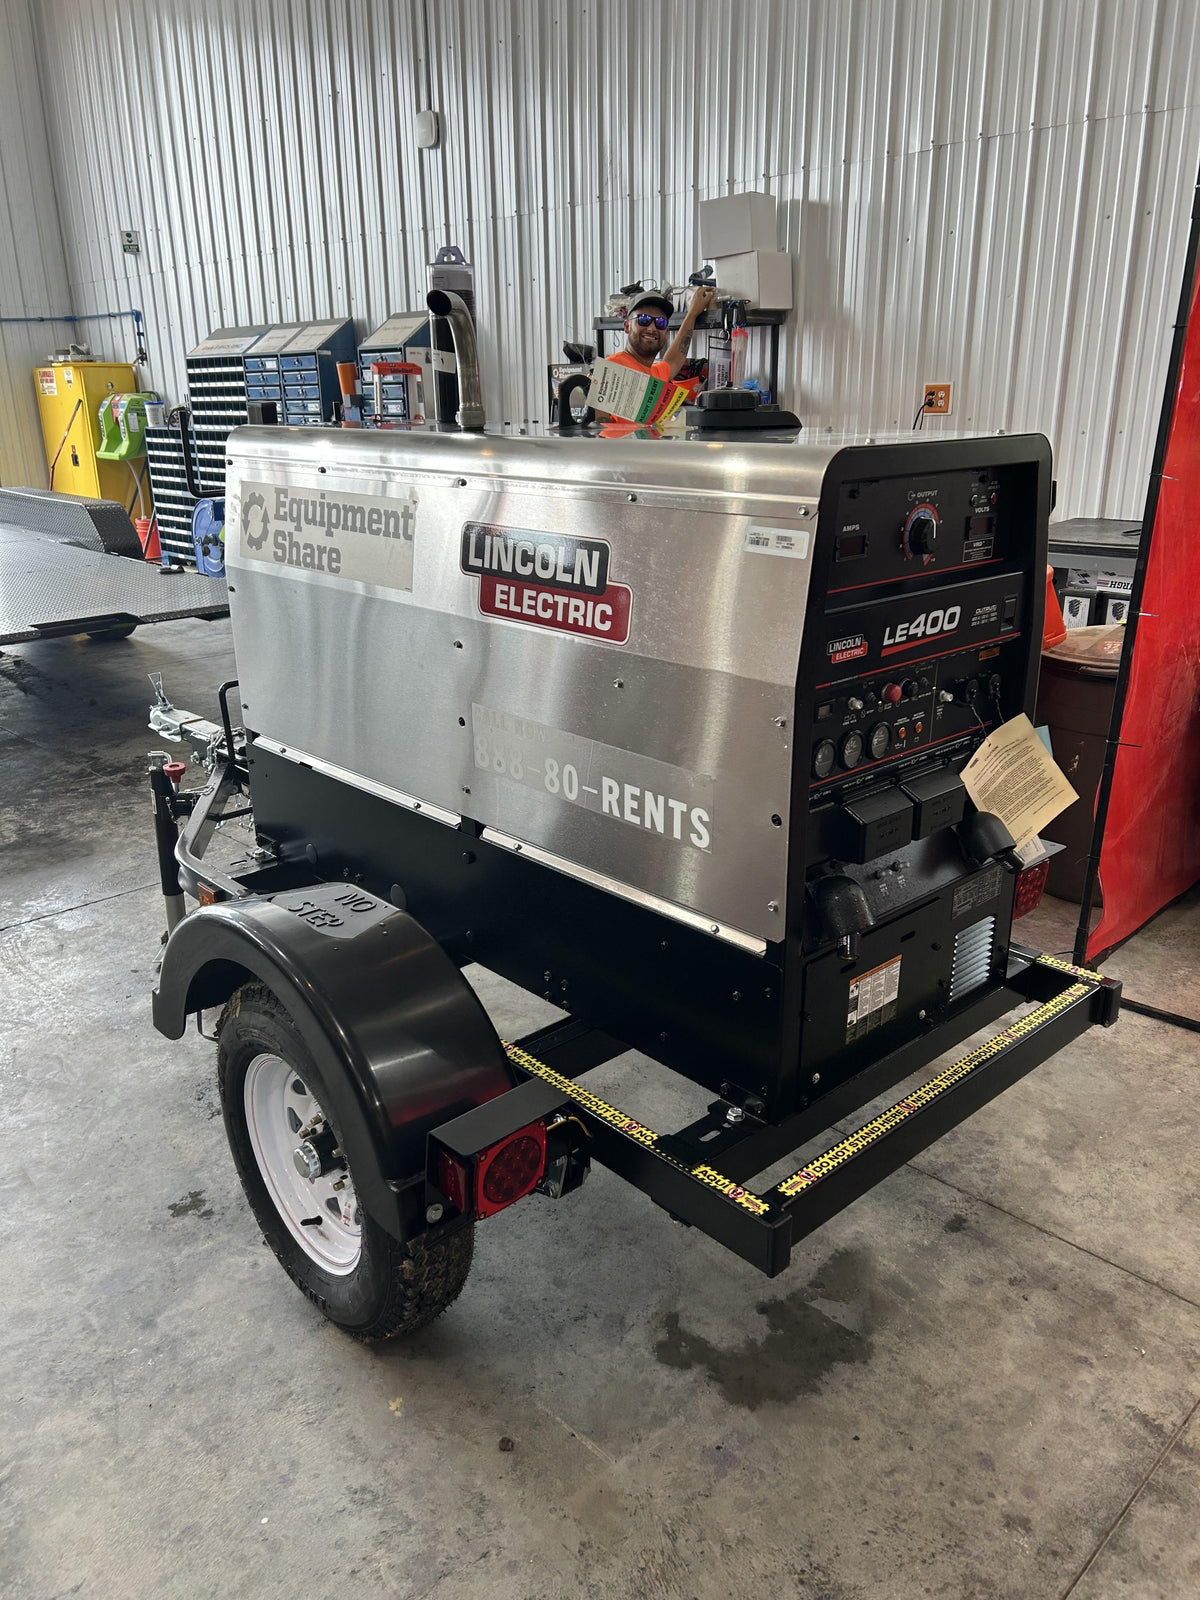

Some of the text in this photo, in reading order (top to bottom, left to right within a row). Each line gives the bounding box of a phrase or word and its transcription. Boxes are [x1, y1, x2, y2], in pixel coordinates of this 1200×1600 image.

[650, 380, 659, 395] RENT
[917, 490, 938, 498] OUTPUT
[274, 487, 413, 541] Equipment
[974, 506, 990, 514] VOLTS
[842, 524, 860, 532] AMPS
[273, 529, 342, 574] Share
[468, 533, 600, 588] LINCOLN
[1109, 581, 1133, 590] RGH
[495, 584, 613, 631] ELECTRIC
[883, 605, 961, 646] LE400
[829, 637, 863, 653] LINCOLN
[836, 647, 864, 660] ELECTRIC
[334, 892, 378, 913] NO
[288, 901, 345, 928] STEP
[512, 1050, 655, 1142] NE PAS TENEZ DEBOUT ICI NO
[814, 1160, 829, 1174] DO
[828, 1145, 850, 1162] NOT
[849, 1125, 881, 1148] STAND
[879, 1109, 905, 1128] HERE
[913, 1093, 926, 1104] NE
[925, 1082, 942, 1096] PAS
[940, 1064, 967, 1085] TENEZ
[964, 1044, 997, 1069] DEBOUT
[994, 1038, 1006, 1048] ICI
[1013, 1023, 1026, 1034] NO
[1024, 1016, 1036, 1027] SE
[1034, 1005, 1052, 1020] PARE
[698, 1168, 729, 1188] AQUI
